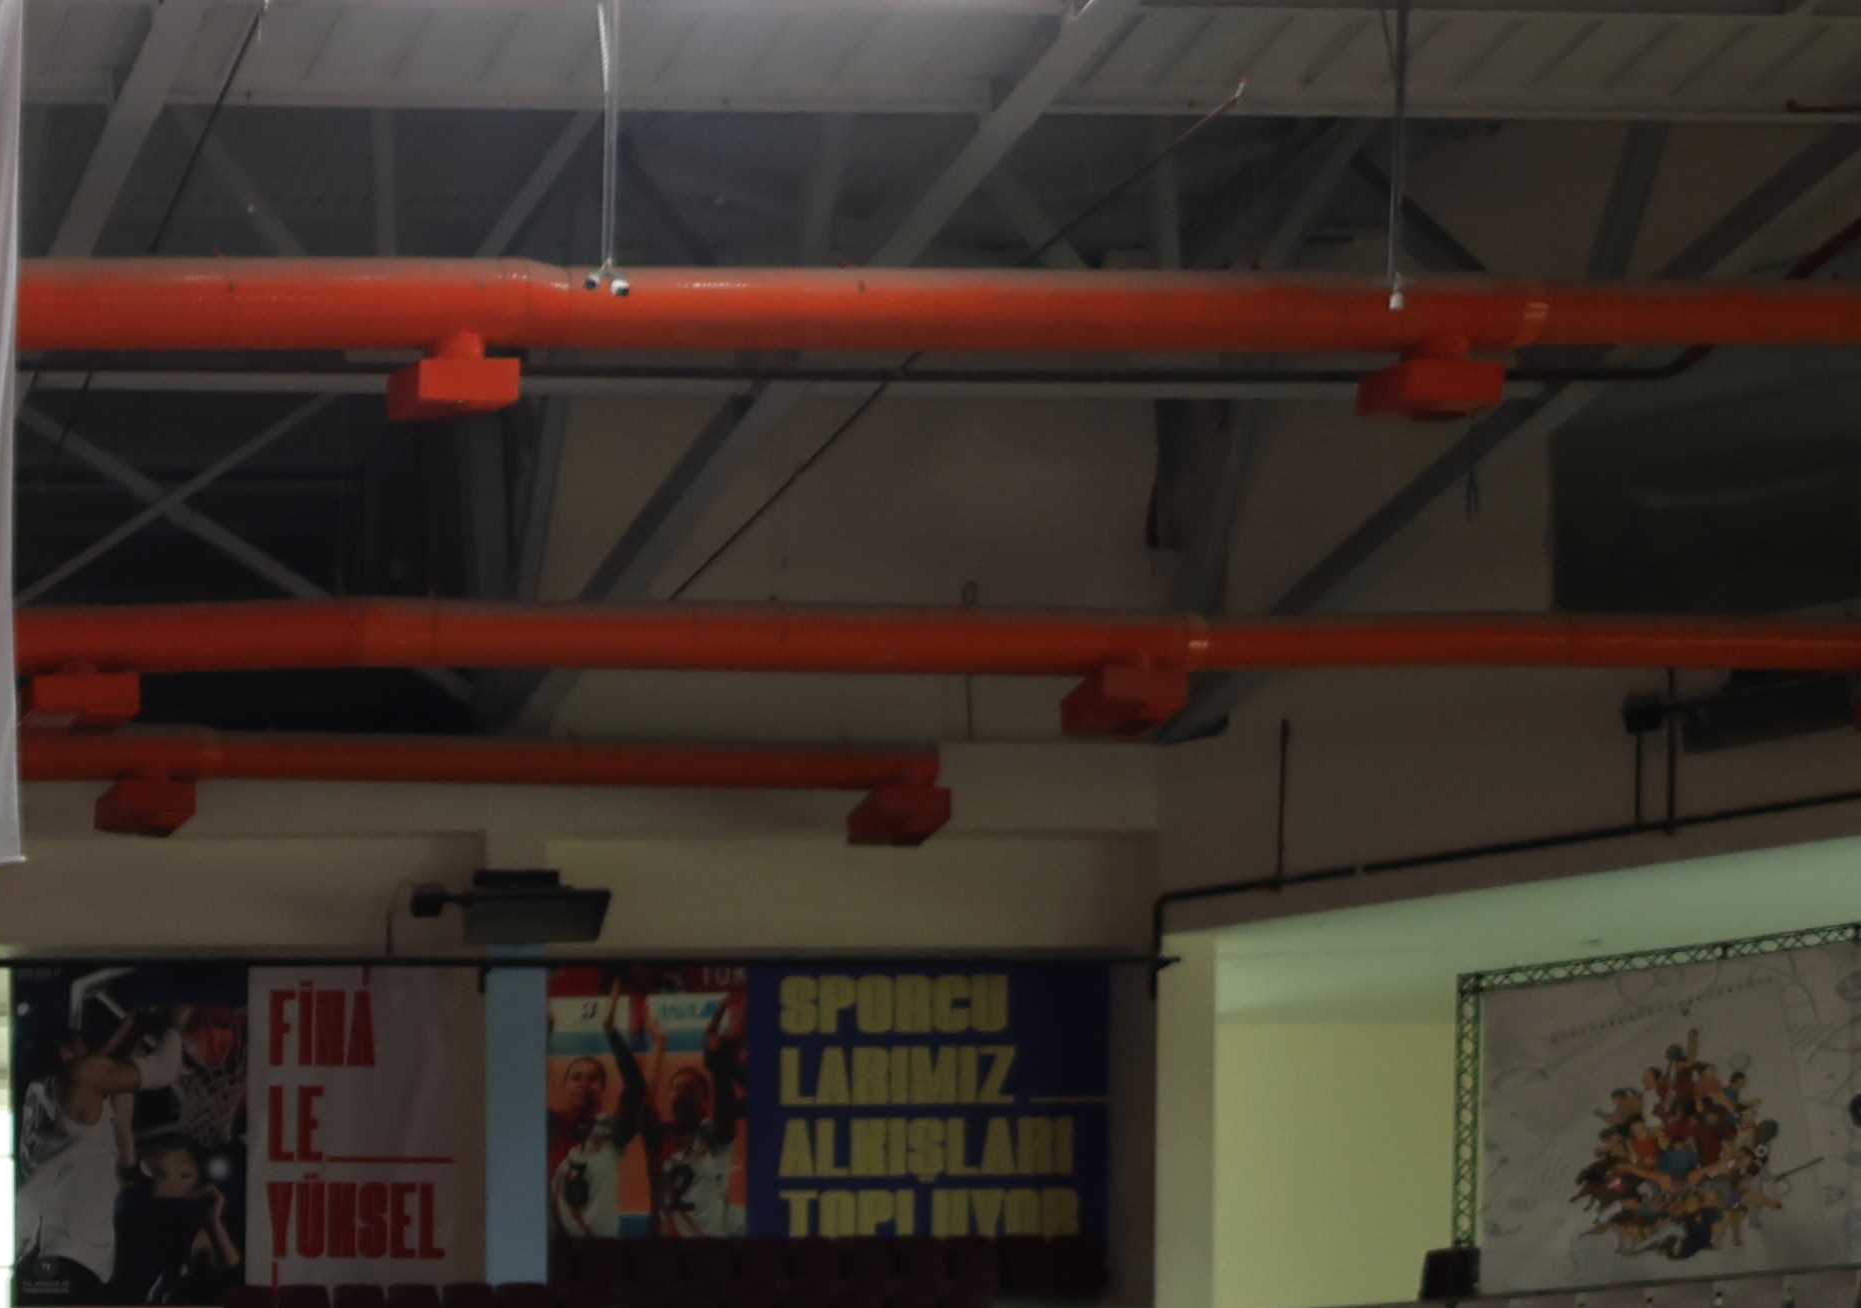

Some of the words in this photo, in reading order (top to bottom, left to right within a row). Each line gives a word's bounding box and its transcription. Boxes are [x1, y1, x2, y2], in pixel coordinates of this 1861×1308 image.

[779, 973, 1011, 1036] SPORCU
[780, 1045, 1017, 1106] LARIMIZ
[778, 1116, 1075, 1185] ALKIŞLARI
[267, 1173, 445, 1259] YÜKSEL
